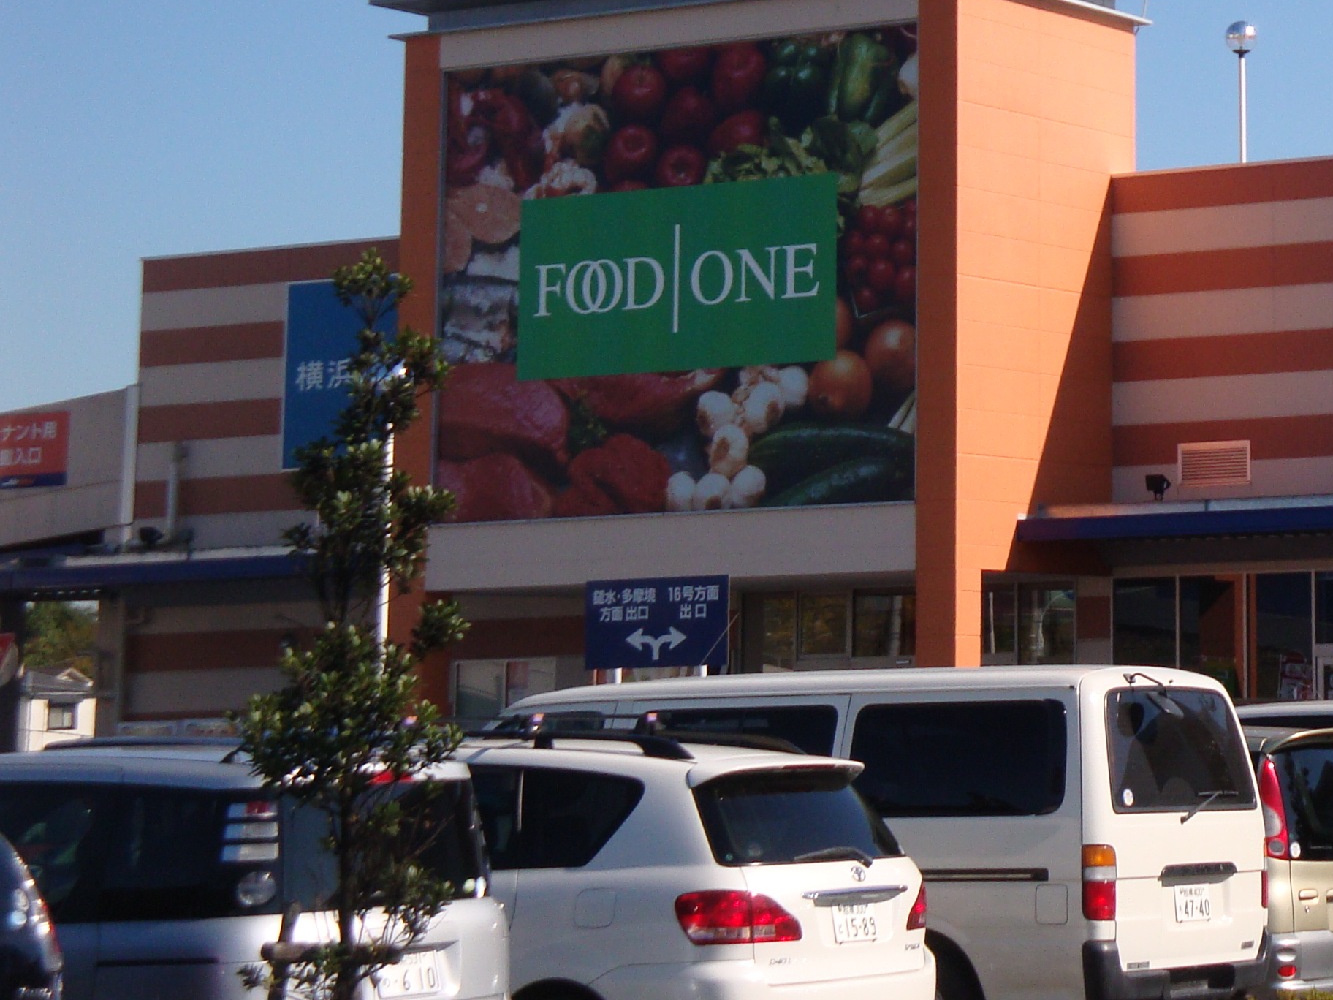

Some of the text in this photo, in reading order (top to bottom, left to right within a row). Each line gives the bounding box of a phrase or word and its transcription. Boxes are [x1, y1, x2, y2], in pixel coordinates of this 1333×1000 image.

[533, 242, 820, 317] FOOD ONE
[668, 585, 719, 602] 16号方面
[680, 603, 707, 619] 出口
